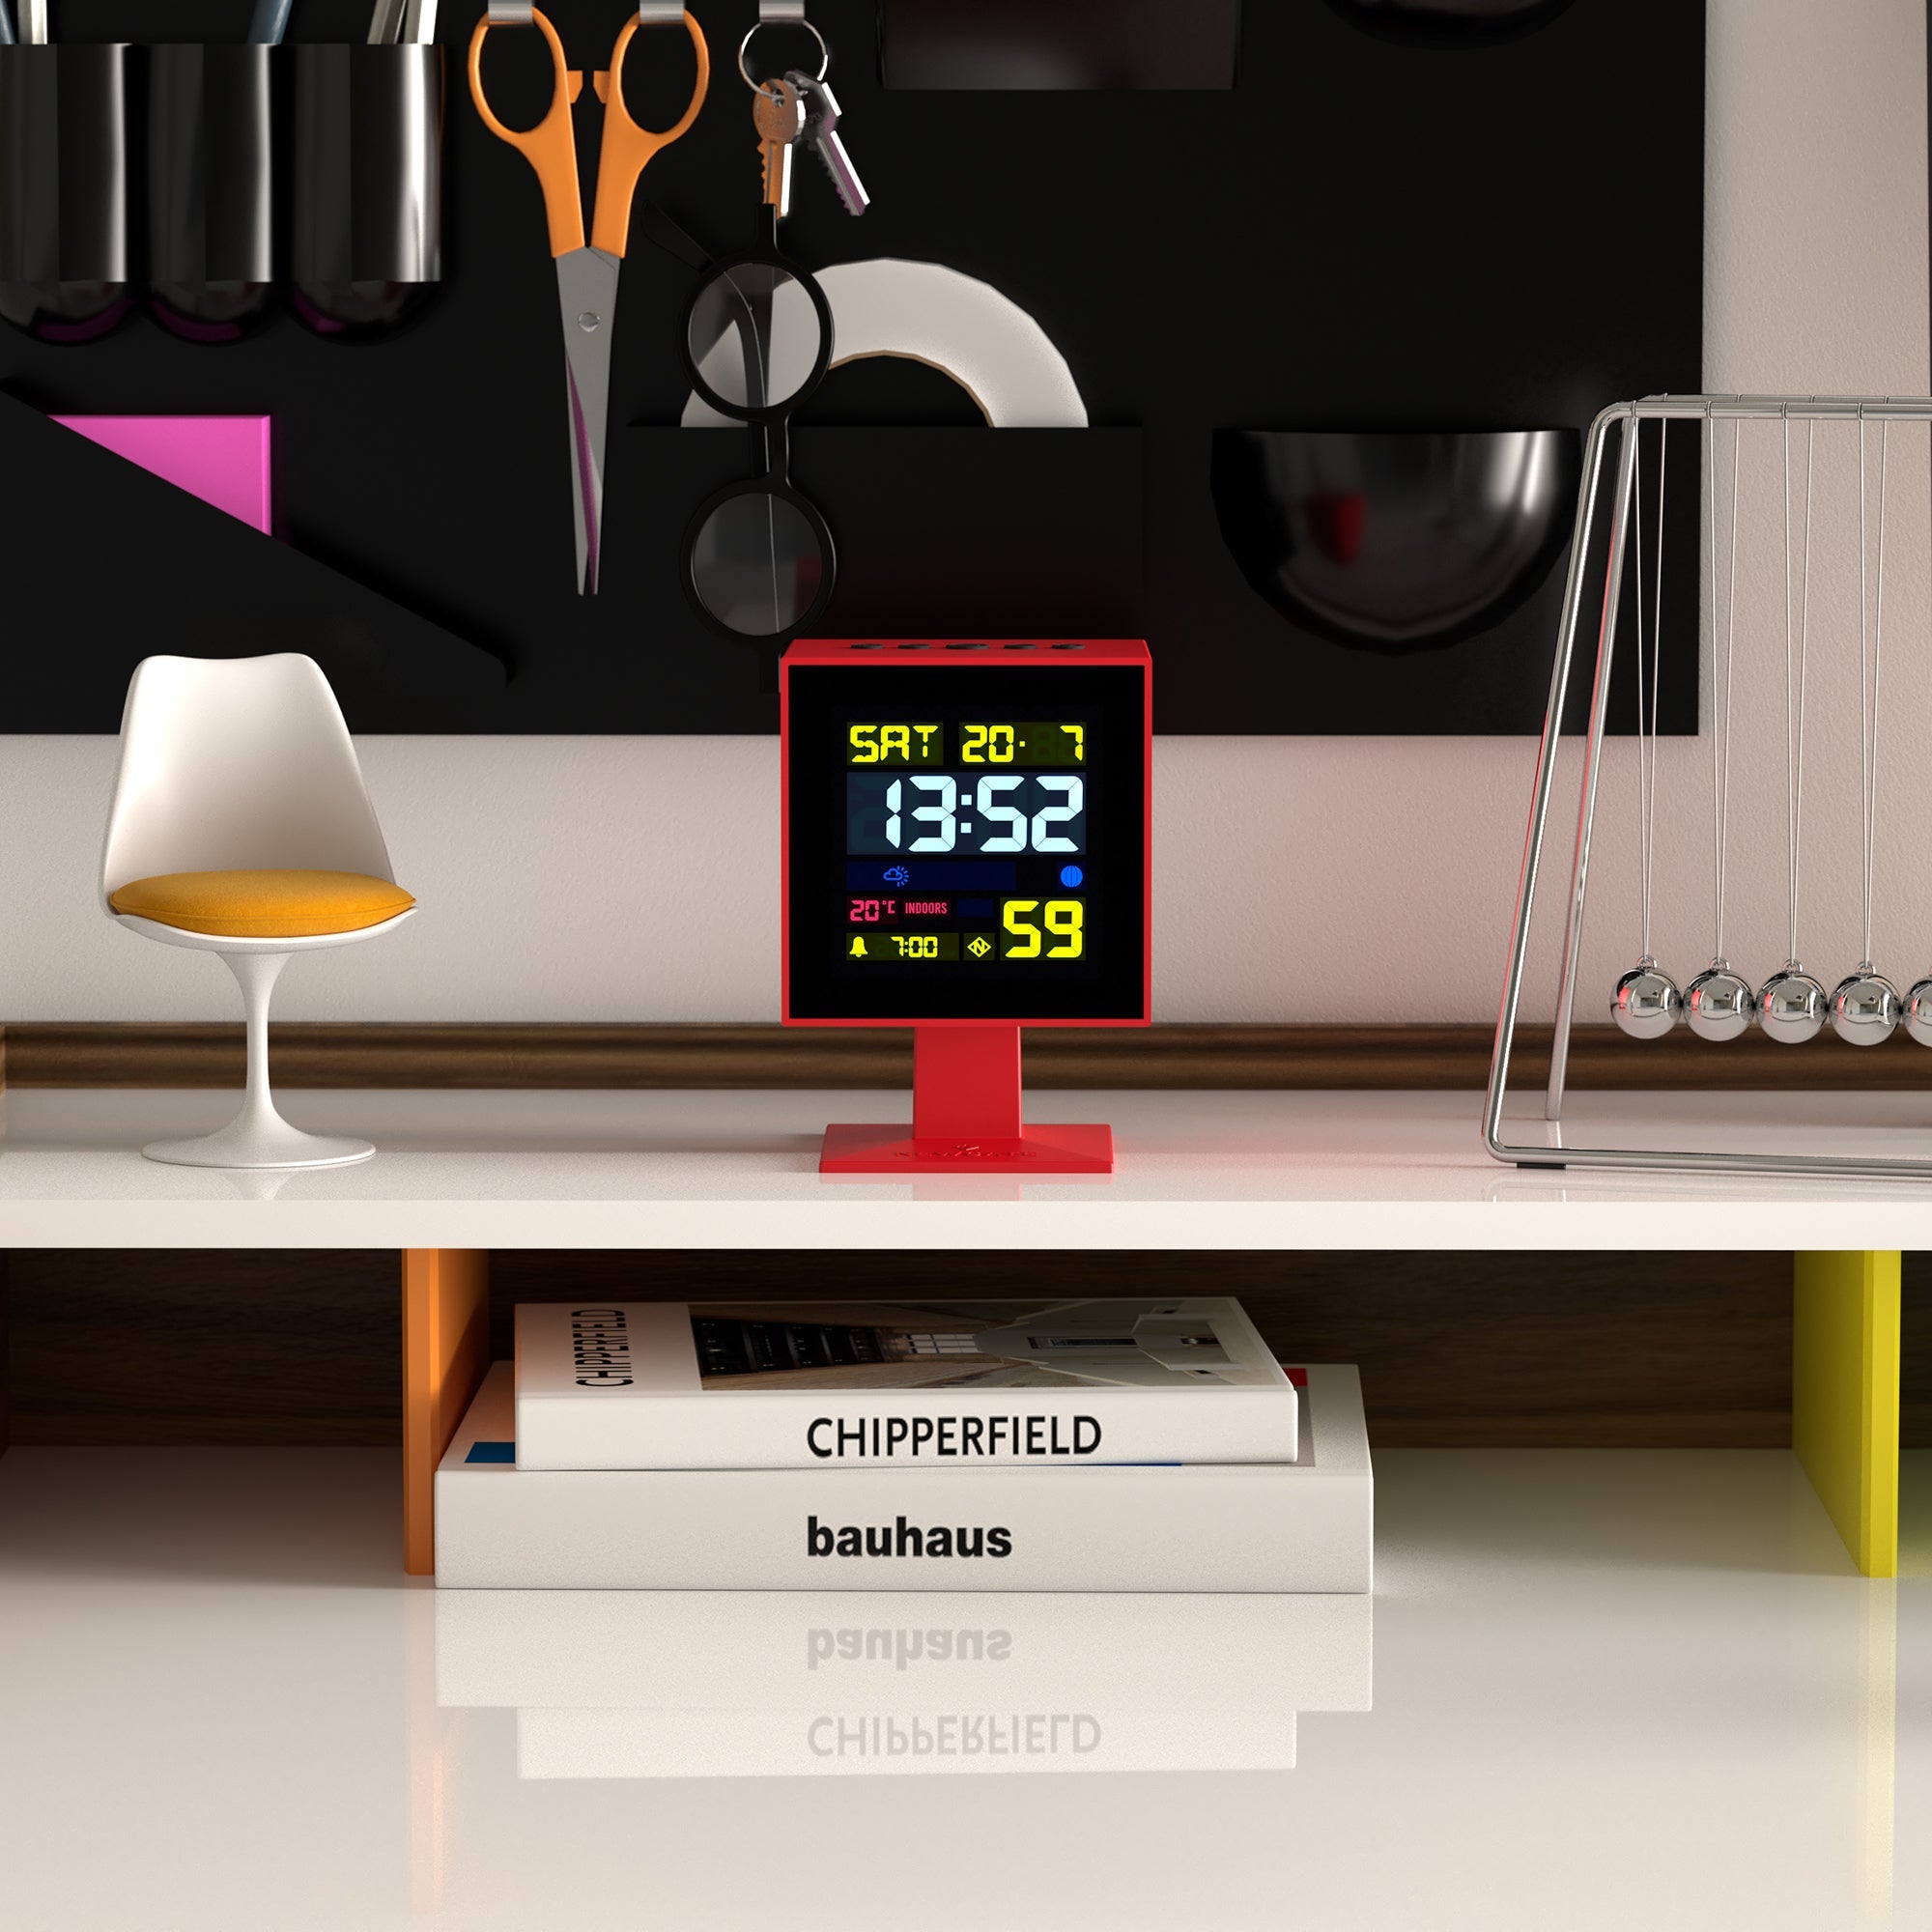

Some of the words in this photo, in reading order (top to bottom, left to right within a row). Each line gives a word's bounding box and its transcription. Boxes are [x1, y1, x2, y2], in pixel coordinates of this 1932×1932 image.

[850, 724, 939, 763] SAT
[1060, 724, 1084, 761] 7
[885, 775, 1084, 853] 13:52
[904, 901, 948, 915] INDOORS
[1003, 900, 1084, 958] 59
[891, 936, 938, 958] 7:00
[571, 1309, 634, 1386] CHIPPERFIELD
[807, 1415, 1101, 1458] CHIPPERFIELD
[807, 1516, 1012, 1558] bauhaus
